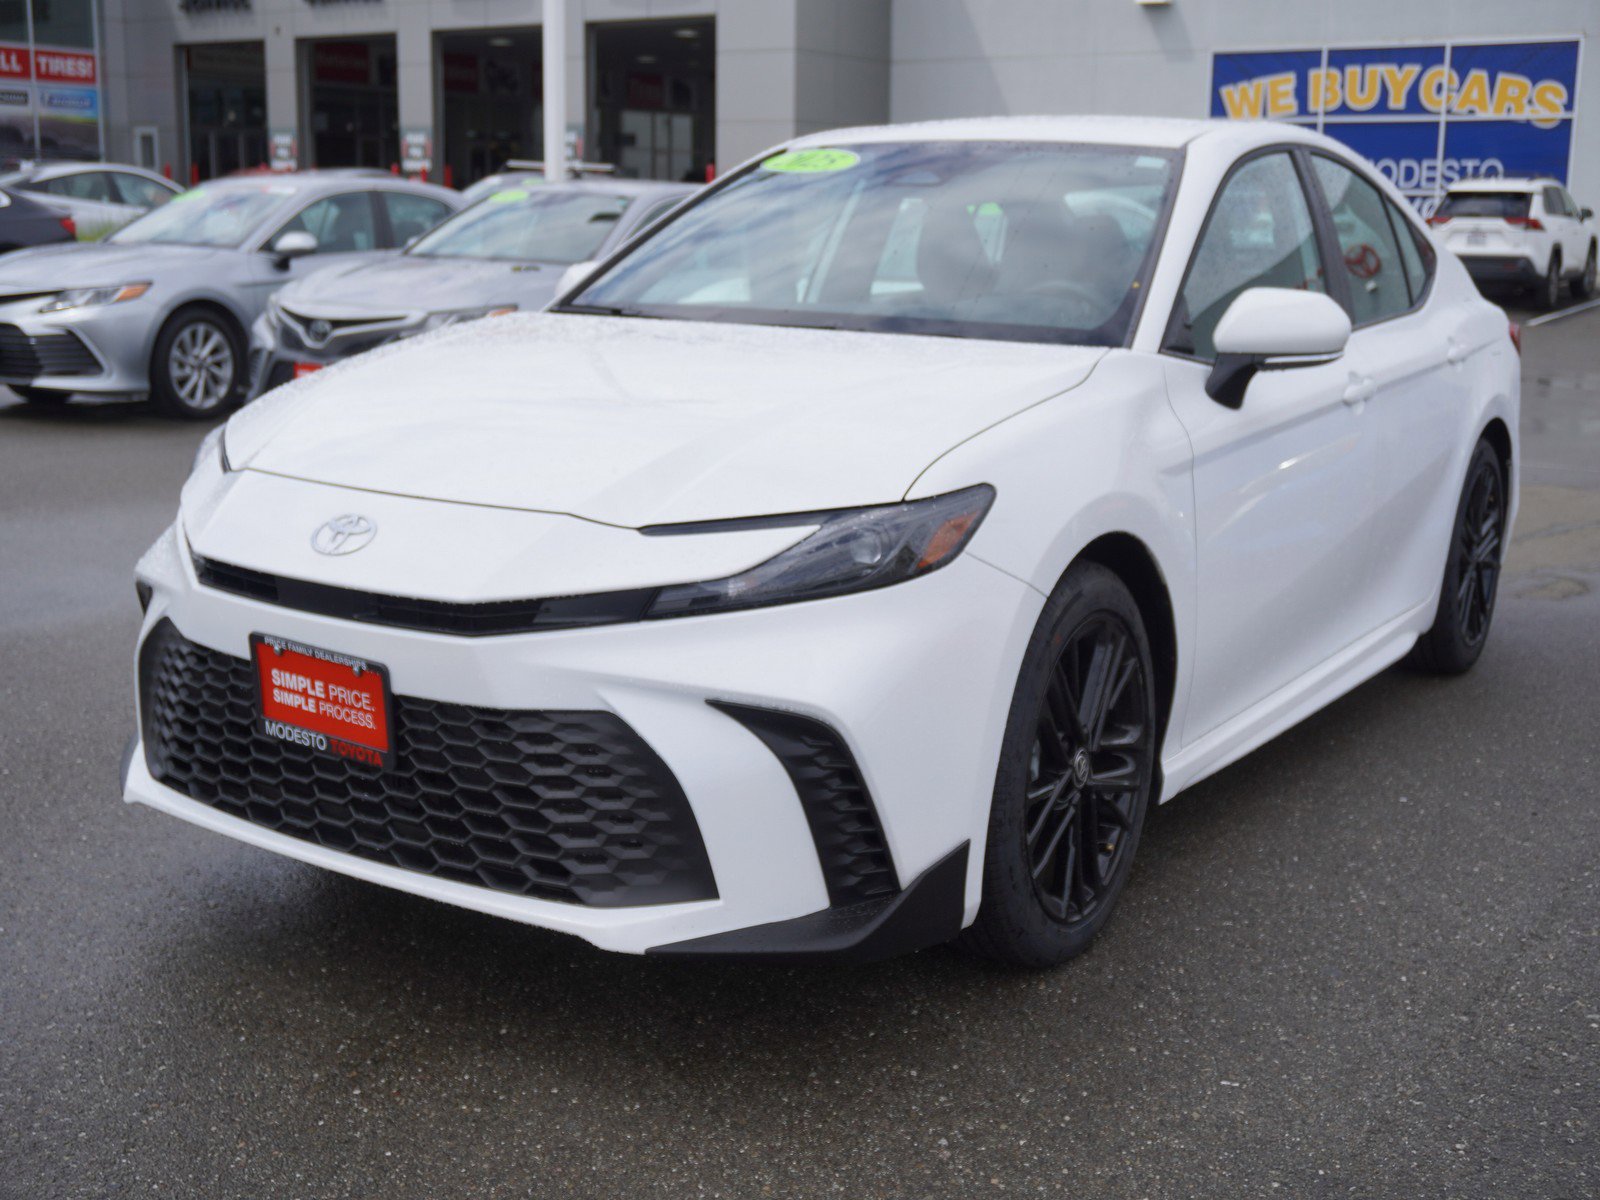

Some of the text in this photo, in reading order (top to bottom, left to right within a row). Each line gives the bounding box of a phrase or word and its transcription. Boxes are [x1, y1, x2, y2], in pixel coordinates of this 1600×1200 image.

[37, 55, 94, 78] TIRES!
[1219, 64, 1568, 129] WE BUY CARS
[1369, 158, 1504, 189] ODESTO
[287, 642, 313, 657] FAMILY
[314, 650, 367, 671] DEALERSHIPS
[271, 668, 376, 712] SIMPLE PRICE.
[273, 687, 377, 730] SIMPLE PROCESS.
[265, 721, 383, 767] MODESTO TOYOTA
